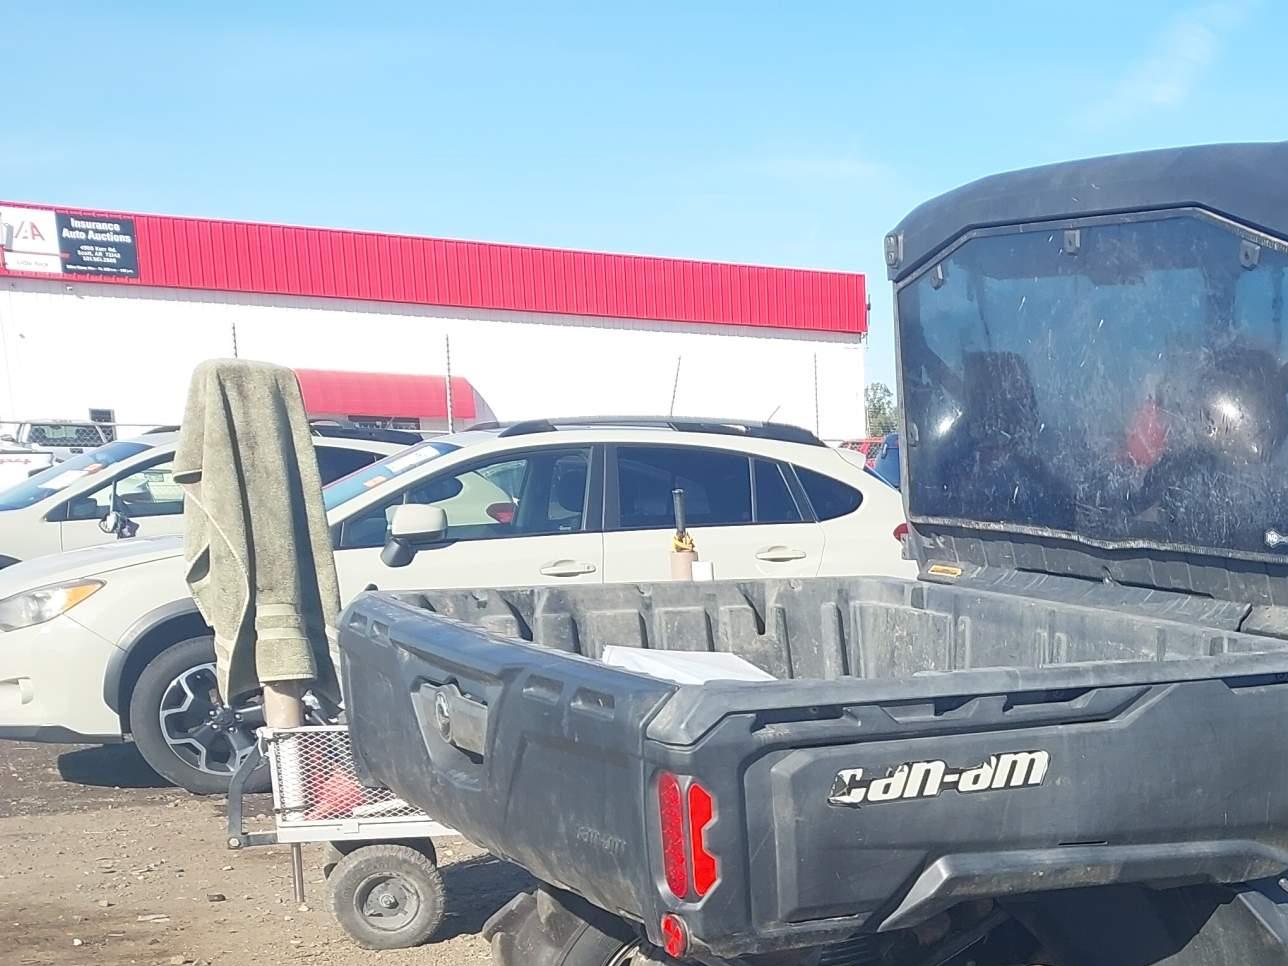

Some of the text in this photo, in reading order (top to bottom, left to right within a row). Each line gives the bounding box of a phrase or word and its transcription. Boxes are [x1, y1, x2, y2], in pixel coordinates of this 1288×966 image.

[70, 217, 120, 231] Insurance
[62, 228, 132, 243] Auto Auctions
